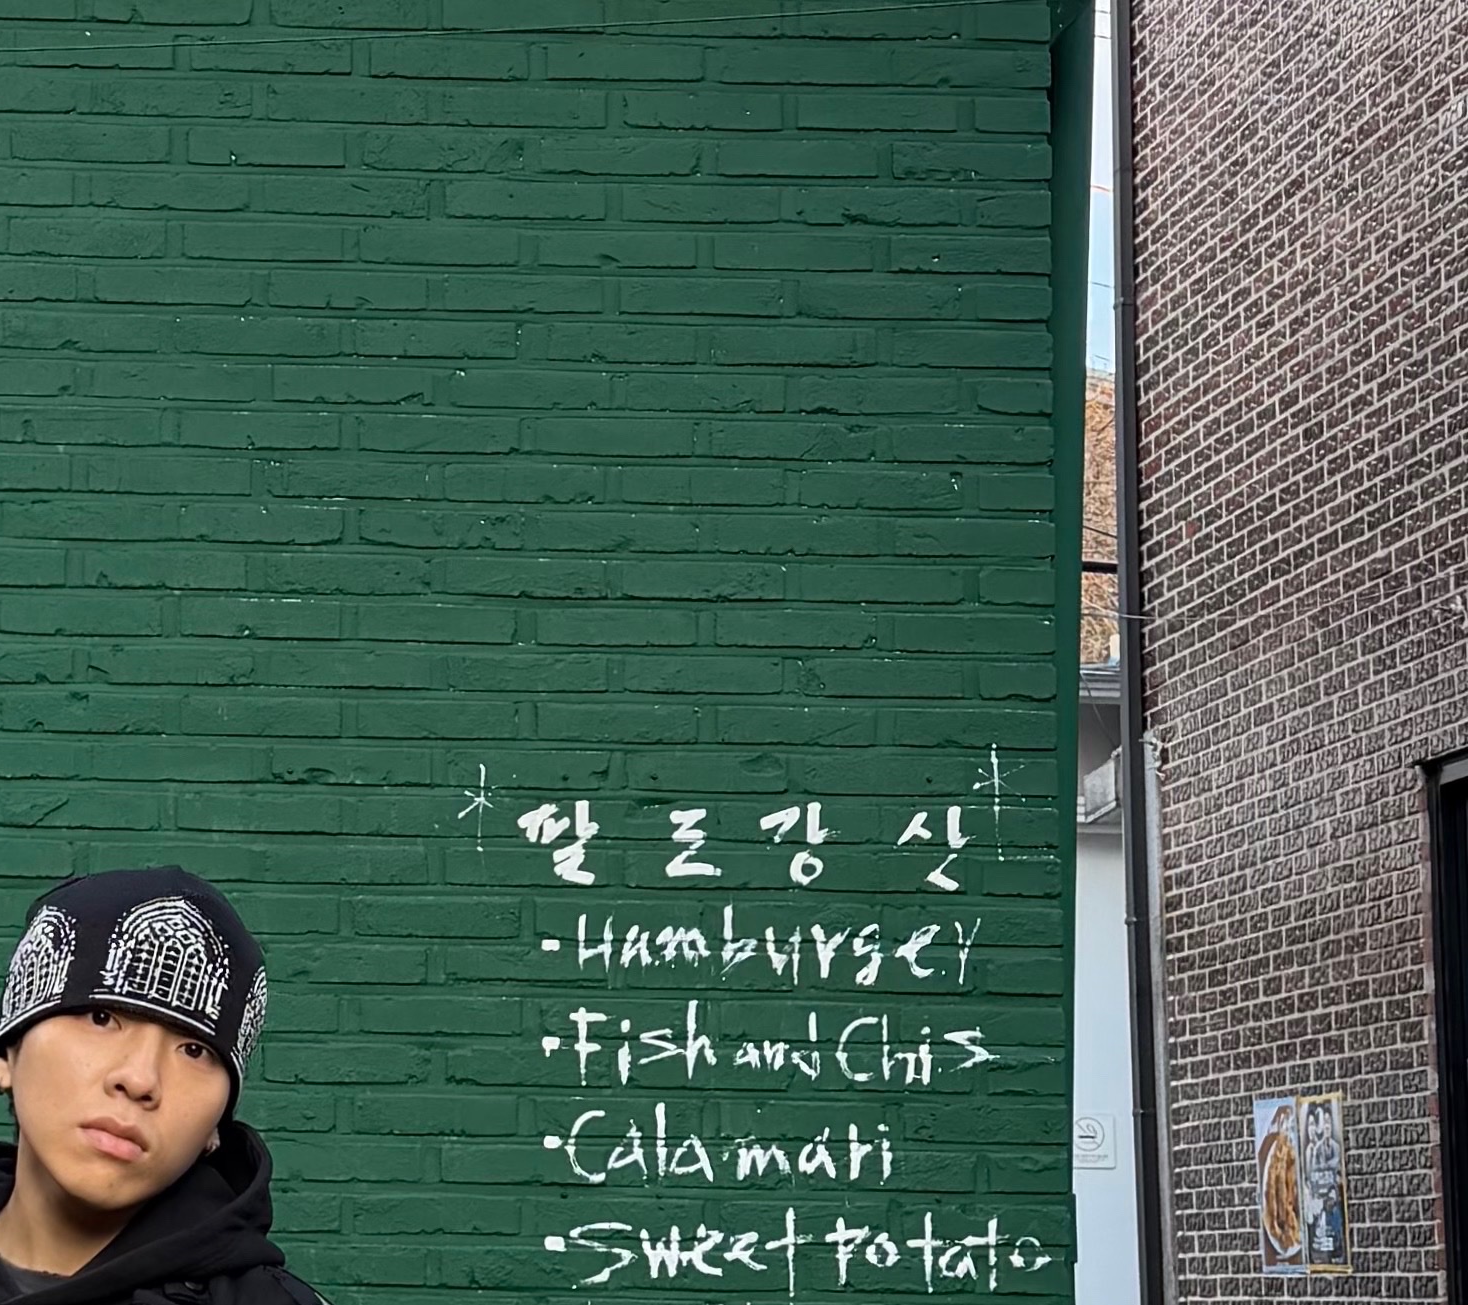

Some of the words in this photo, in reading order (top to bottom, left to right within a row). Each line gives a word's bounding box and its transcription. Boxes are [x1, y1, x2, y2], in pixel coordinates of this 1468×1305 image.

[568, 1000, 717, 1085] Fish
[733, 1011, 820, 1081] and
[565, 1102, 893, 1185] Calamari
